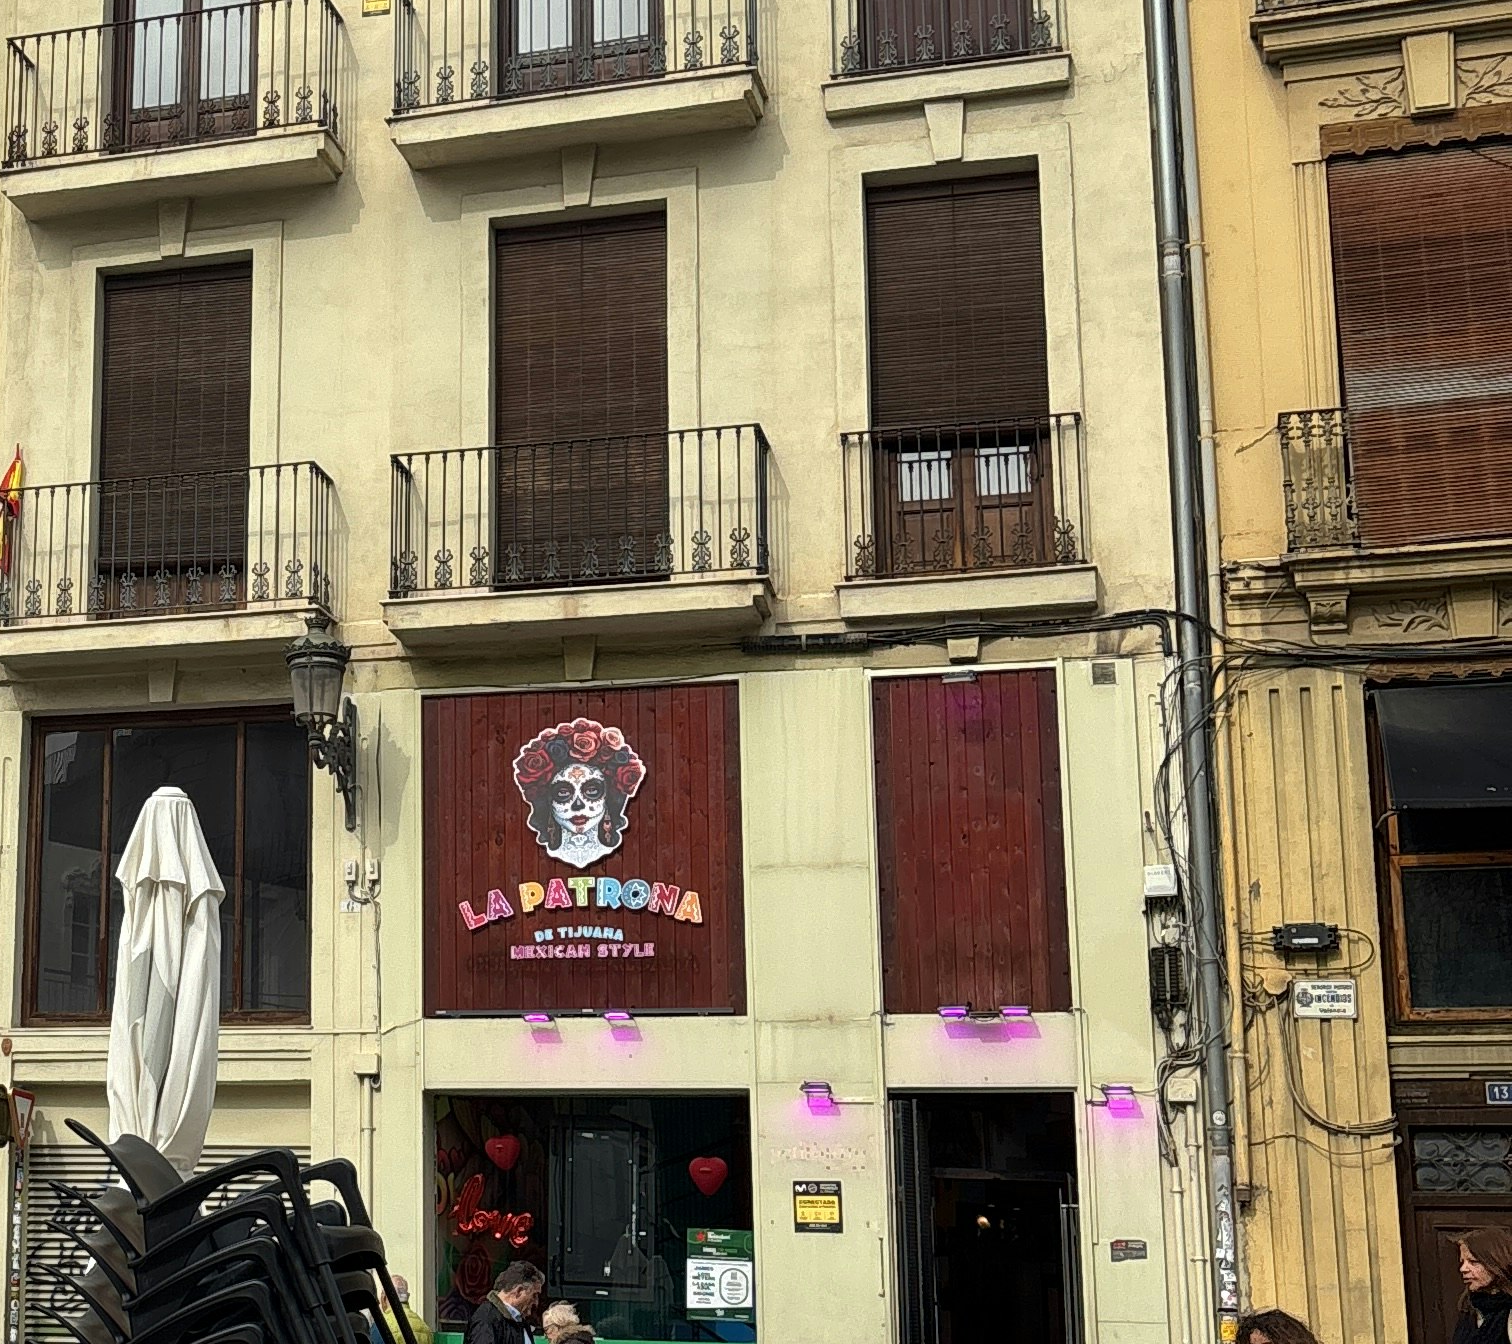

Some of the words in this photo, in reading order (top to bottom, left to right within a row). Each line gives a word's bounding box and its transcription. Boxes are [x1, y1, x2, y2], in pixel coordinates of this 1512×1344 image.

[459, 889, 514, 931] LA
[518, 876, 703, 924] PATRONA
[534, 930, 554, 942] DE
[556, 925, 624, 942] TIJUANA
[510, 944, 591, 960] MEXICAN
[596, 942, 655, 958] STYLE
